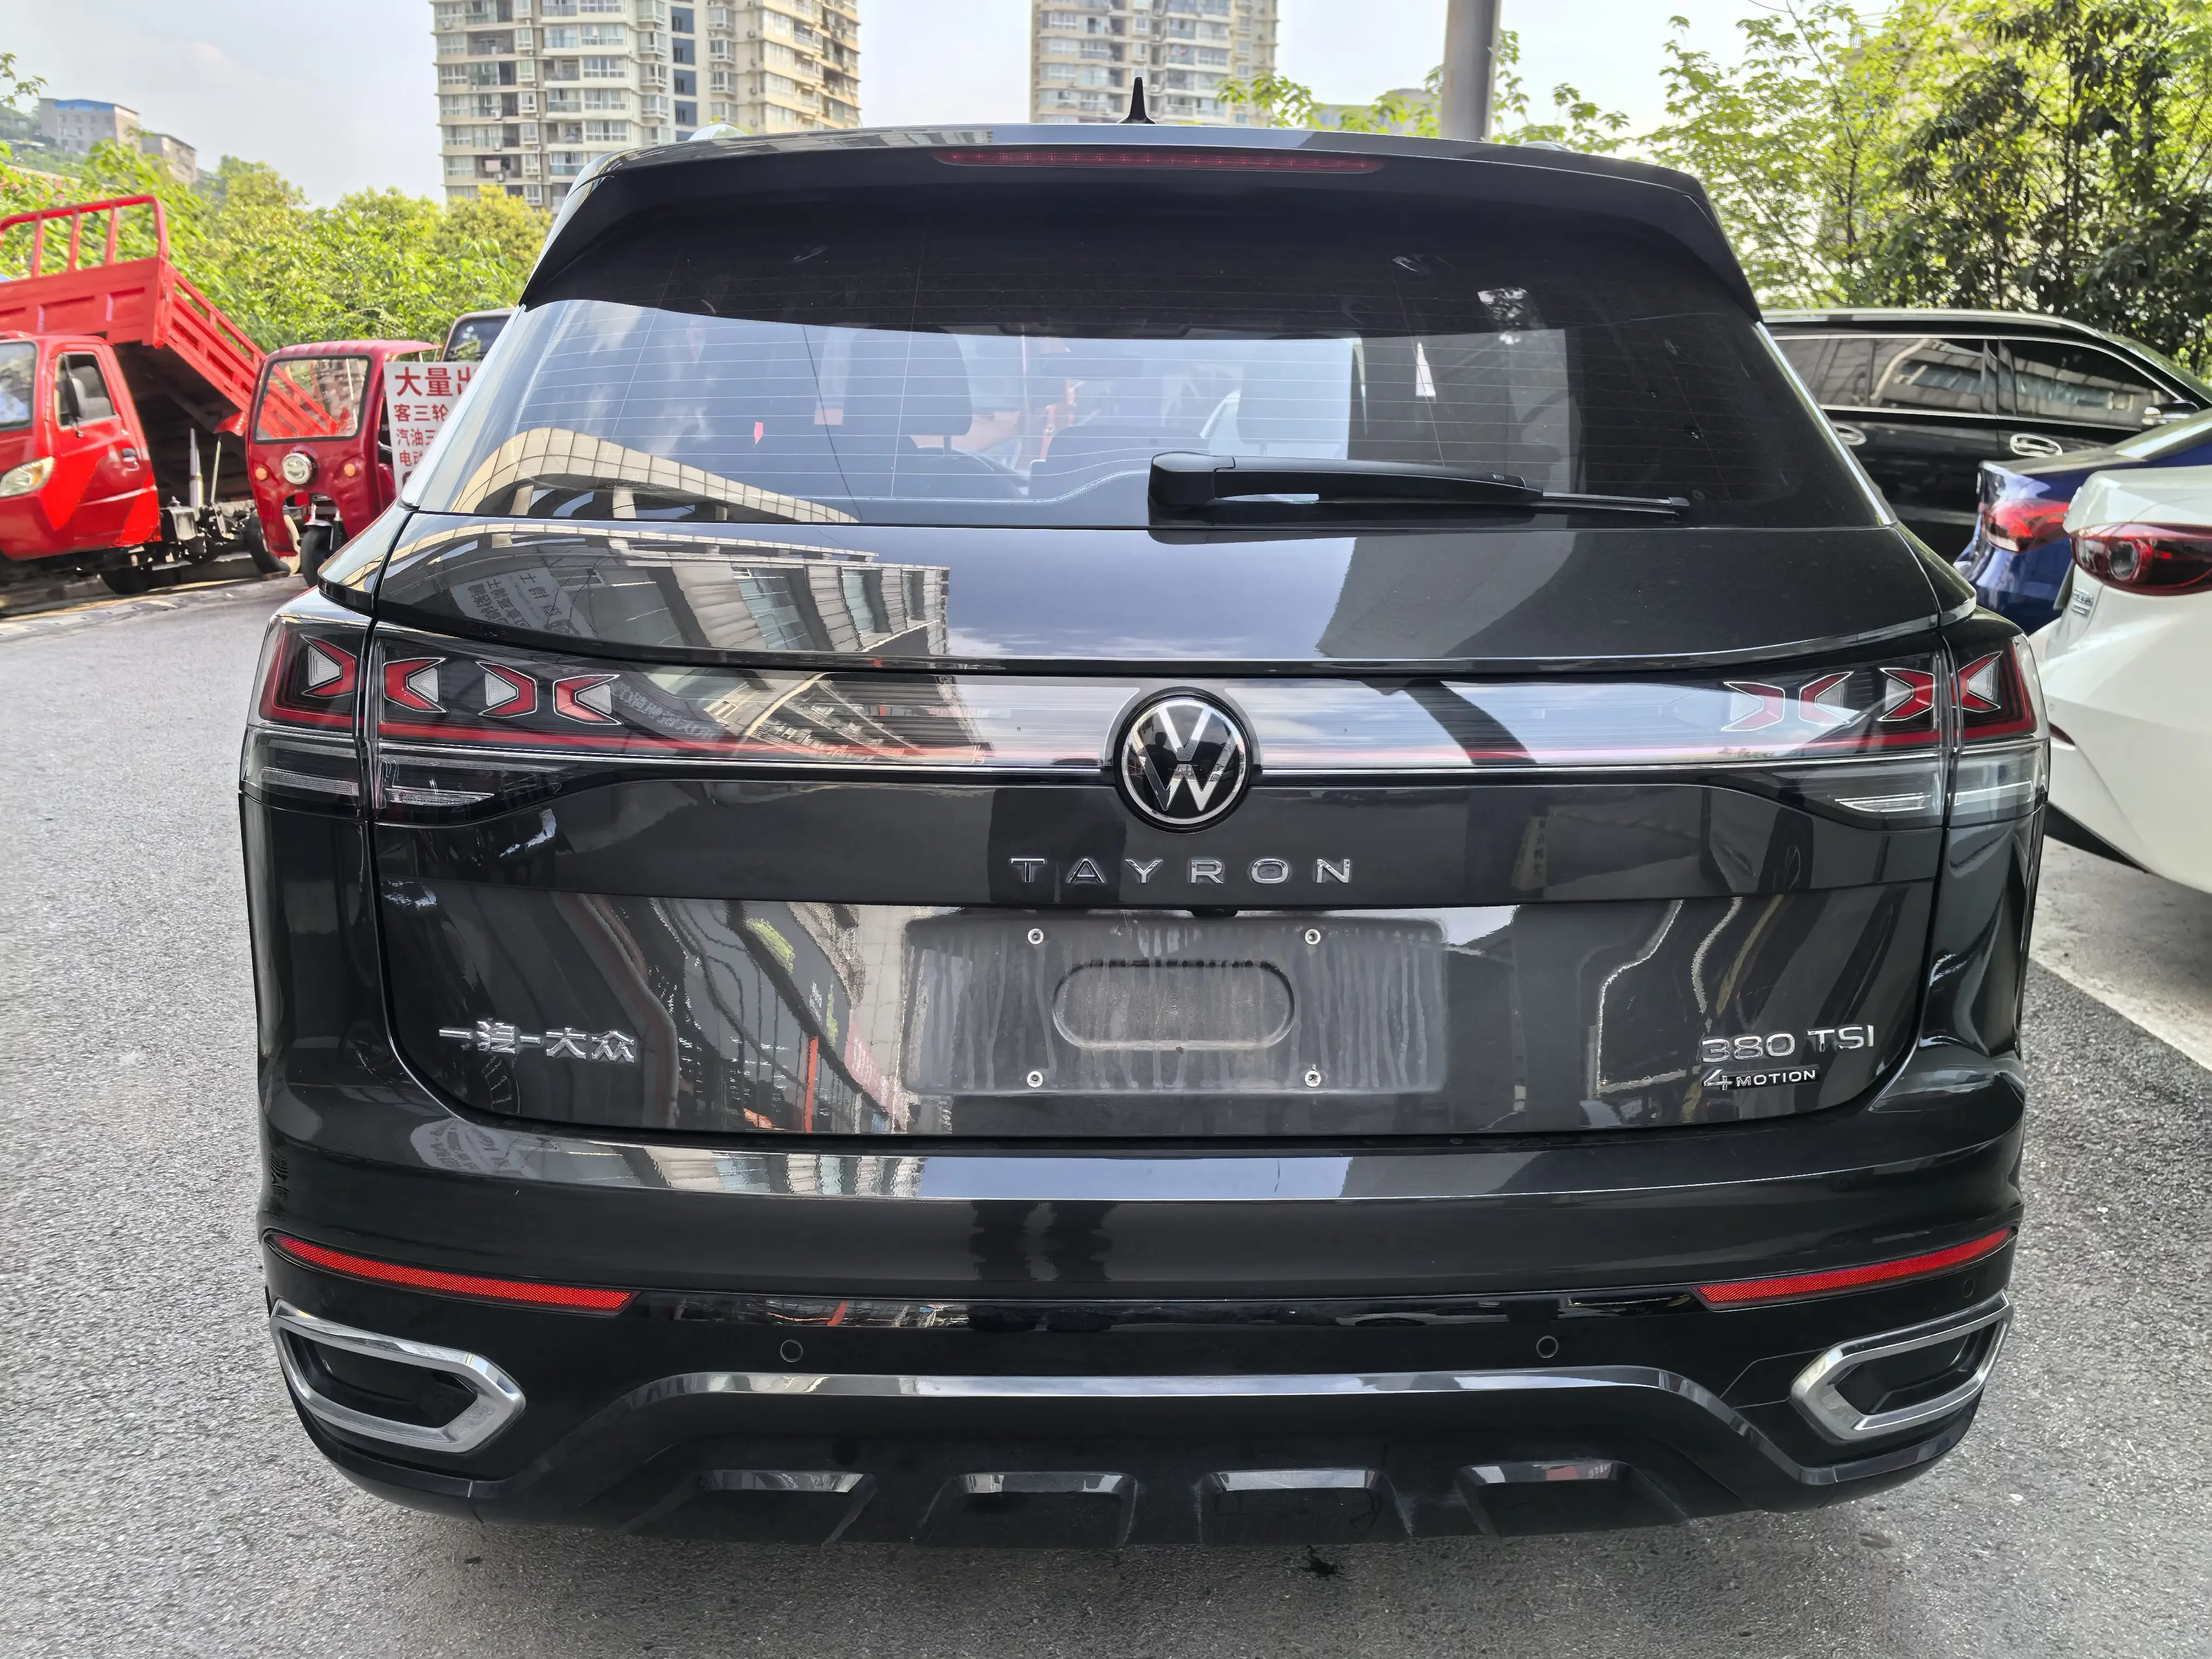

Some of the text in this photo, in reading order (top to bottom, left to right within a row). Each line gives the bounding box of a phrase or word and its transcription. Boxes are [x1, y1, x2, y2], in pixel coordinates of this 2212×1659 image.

[394, 403, 449, 422] 客三轮
[1010, 858, 1350, 884] TAYRON
[1701, 1025, 1874, 1063] 380 TSI
[1703, 1069, 1816, 1091] 4MOTION
